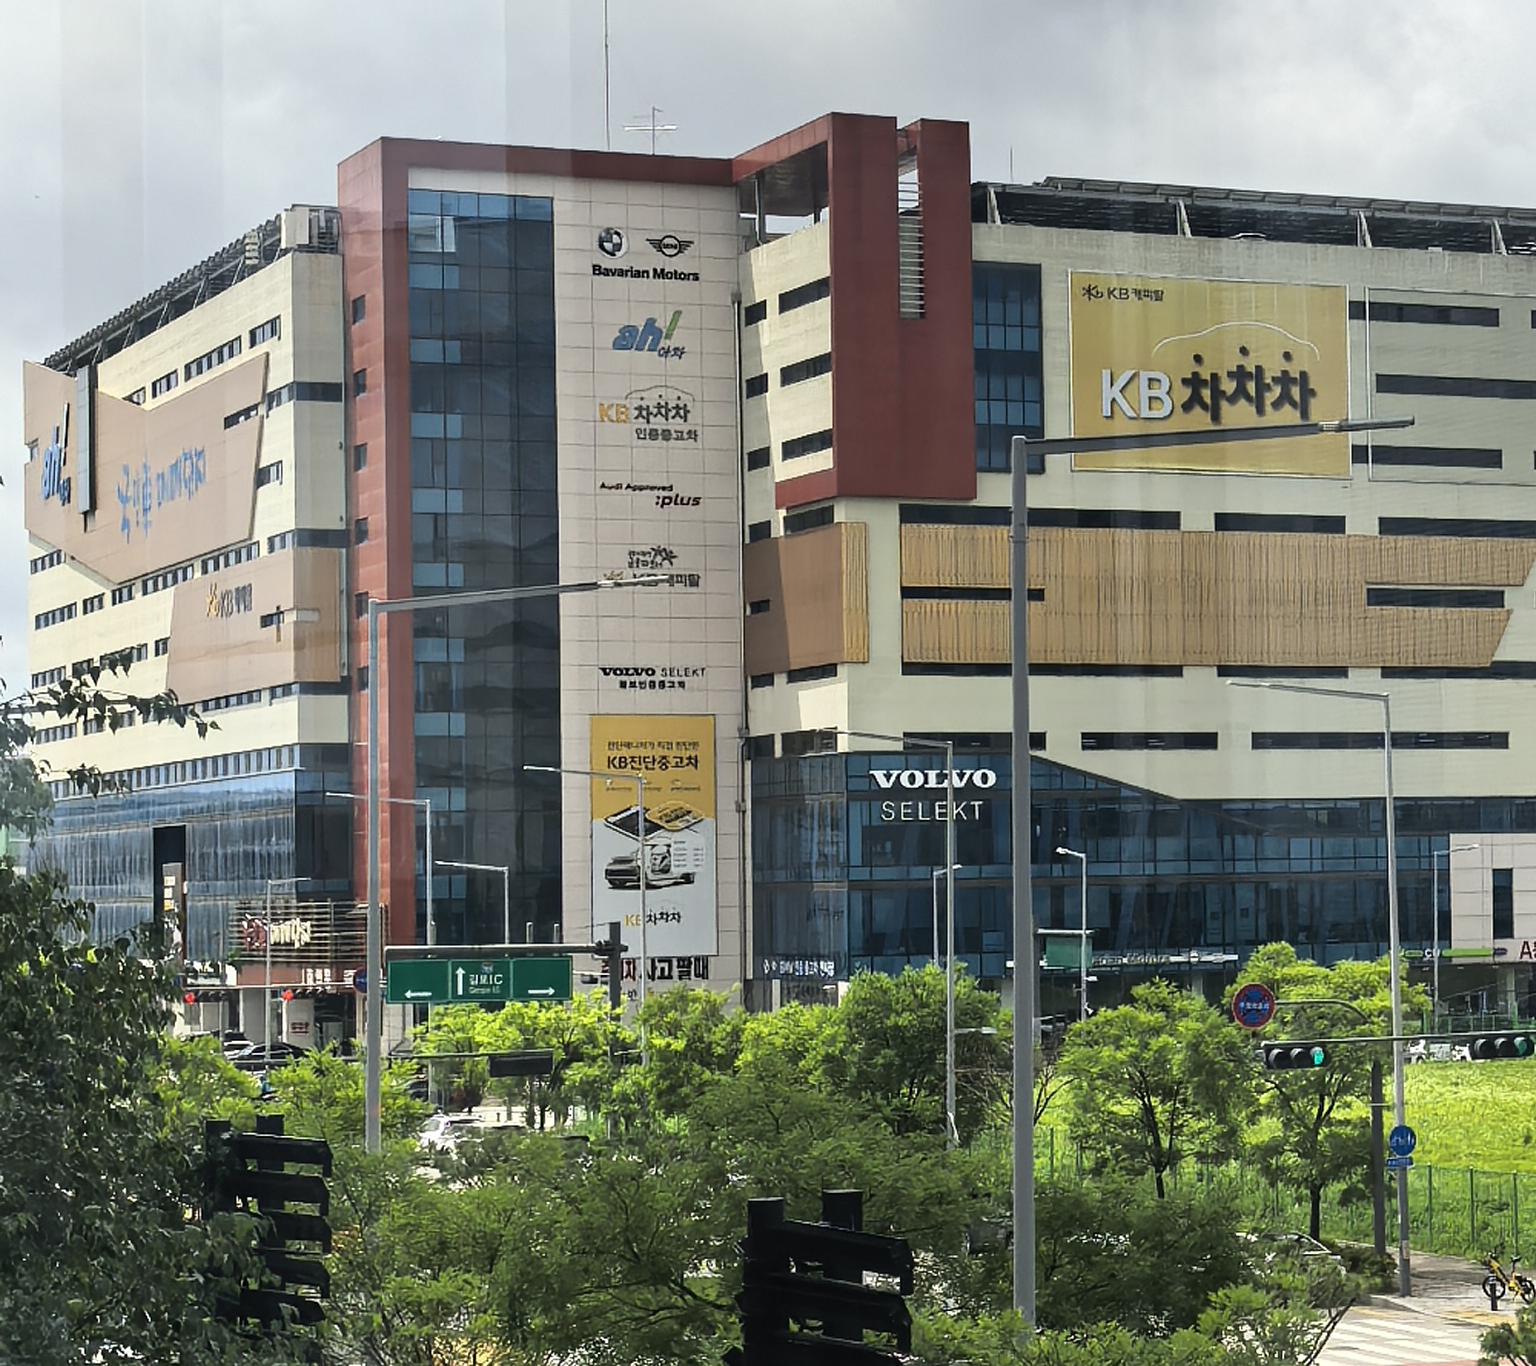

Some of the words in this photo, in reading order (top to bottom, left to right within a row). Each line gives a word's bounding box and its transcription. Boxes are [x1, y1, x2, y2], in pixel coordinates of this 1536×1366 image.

[592, 264, 650, 280] Bavarian
[652, 267, 700, 282] Motors
[1107, 287, 1130, 300] KB
[1101, 369, 1174, 419] KB
[1180, 345, 1317, 425] 차차차
[598, 666, 657, 677] VOLVO
[660, 666, 707, 678] SELEKT
[607, 754, 699, 772] KB진단중고차
[869, 768, 997, 789] VOLVO
[881, 800, 984, 821] SELEKT
